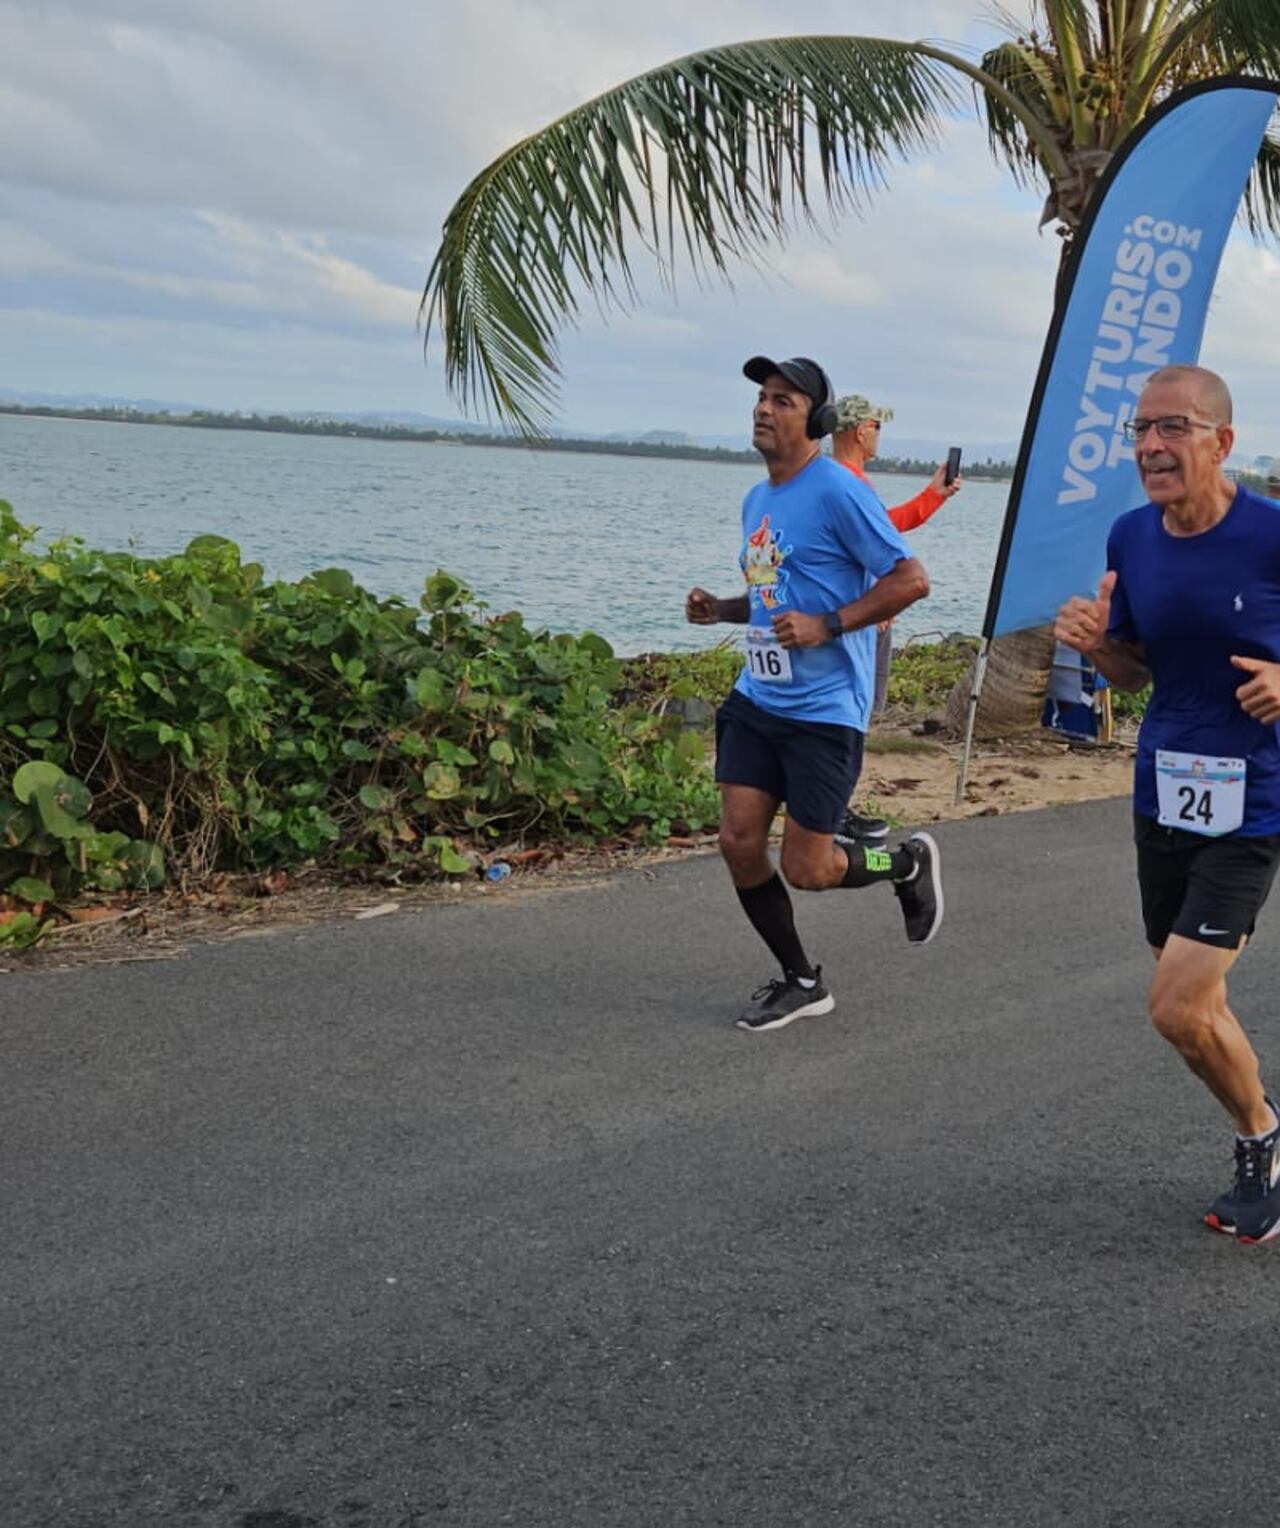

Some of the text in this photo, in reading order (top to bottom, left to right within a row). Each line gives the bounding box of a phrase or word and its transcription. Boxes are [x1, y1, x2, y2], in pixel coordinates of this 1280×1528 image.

[1123, 213, 1203, 253] .COM
[1058, 240, 1154, 505] VOYTURIS
[1178, 785, 1213, 826] 24
